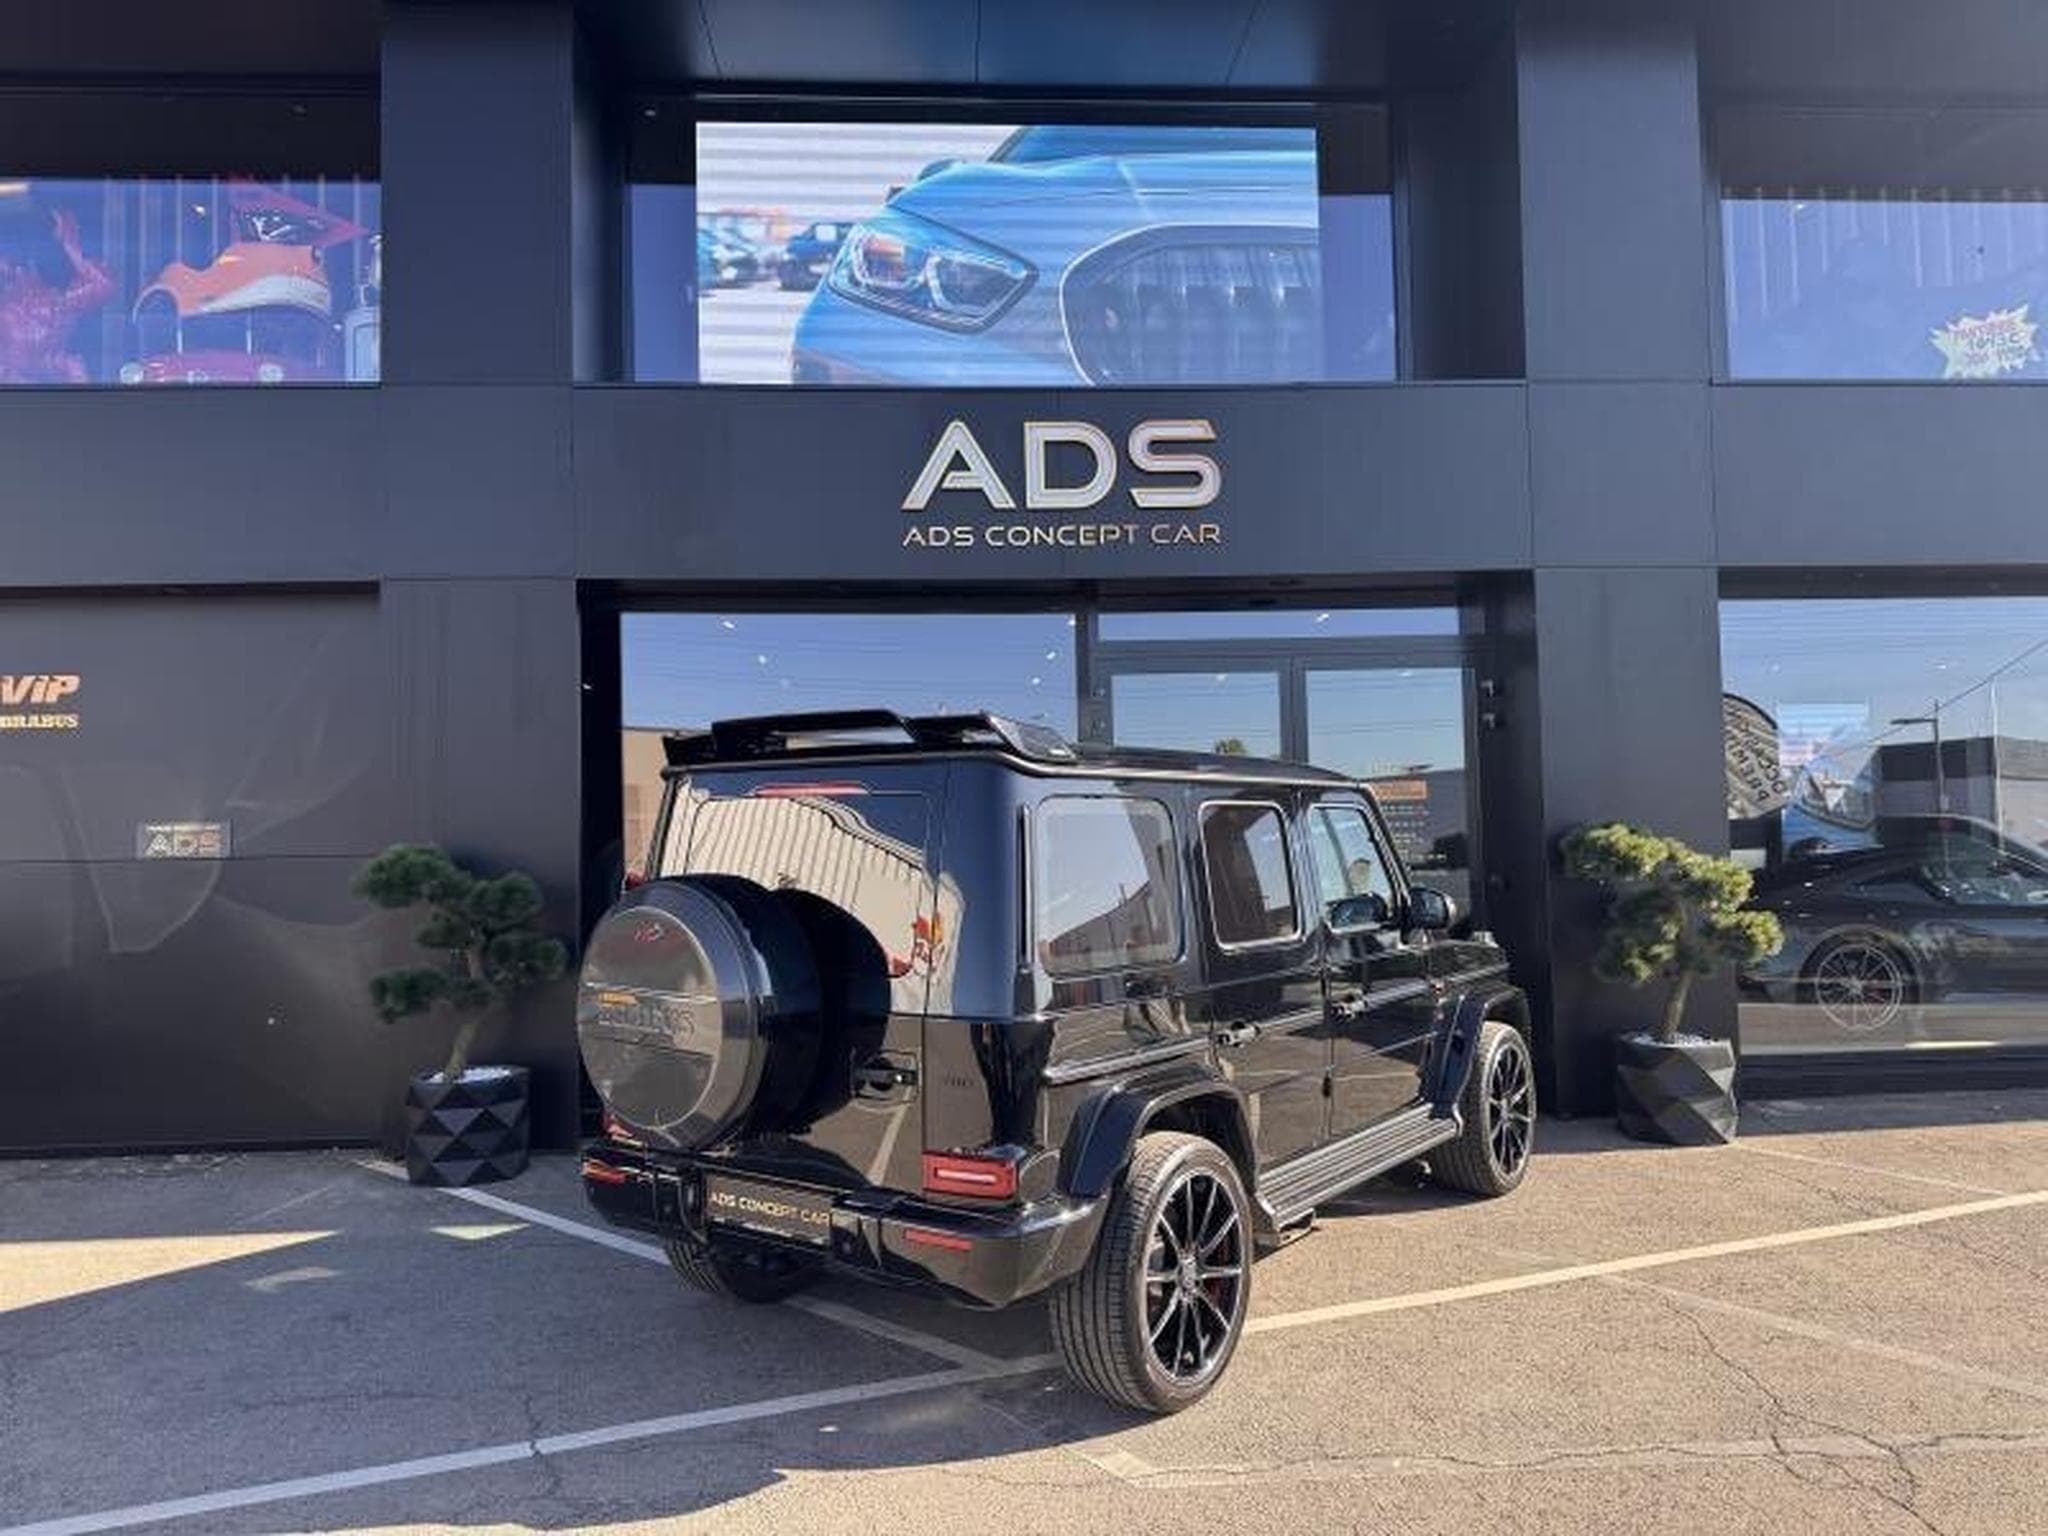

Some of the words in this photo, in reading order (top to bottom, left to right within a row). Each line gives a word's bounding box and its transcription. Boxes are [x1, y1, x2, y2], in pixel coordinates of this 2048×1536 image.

[901, 419, 1222, 509] ADS
[902, 526, 974, 547] ADS
[985, 525, 1139, 547] CONCEPT
[1151, 523, 1221, 545] CAR
[145, 833, 222, 858] ADS
[711, 1191, 736, 1207] ADS
[739, 1196, 799, 1219] CONCEPT
[800, 1208, 830, 1227] CAR
